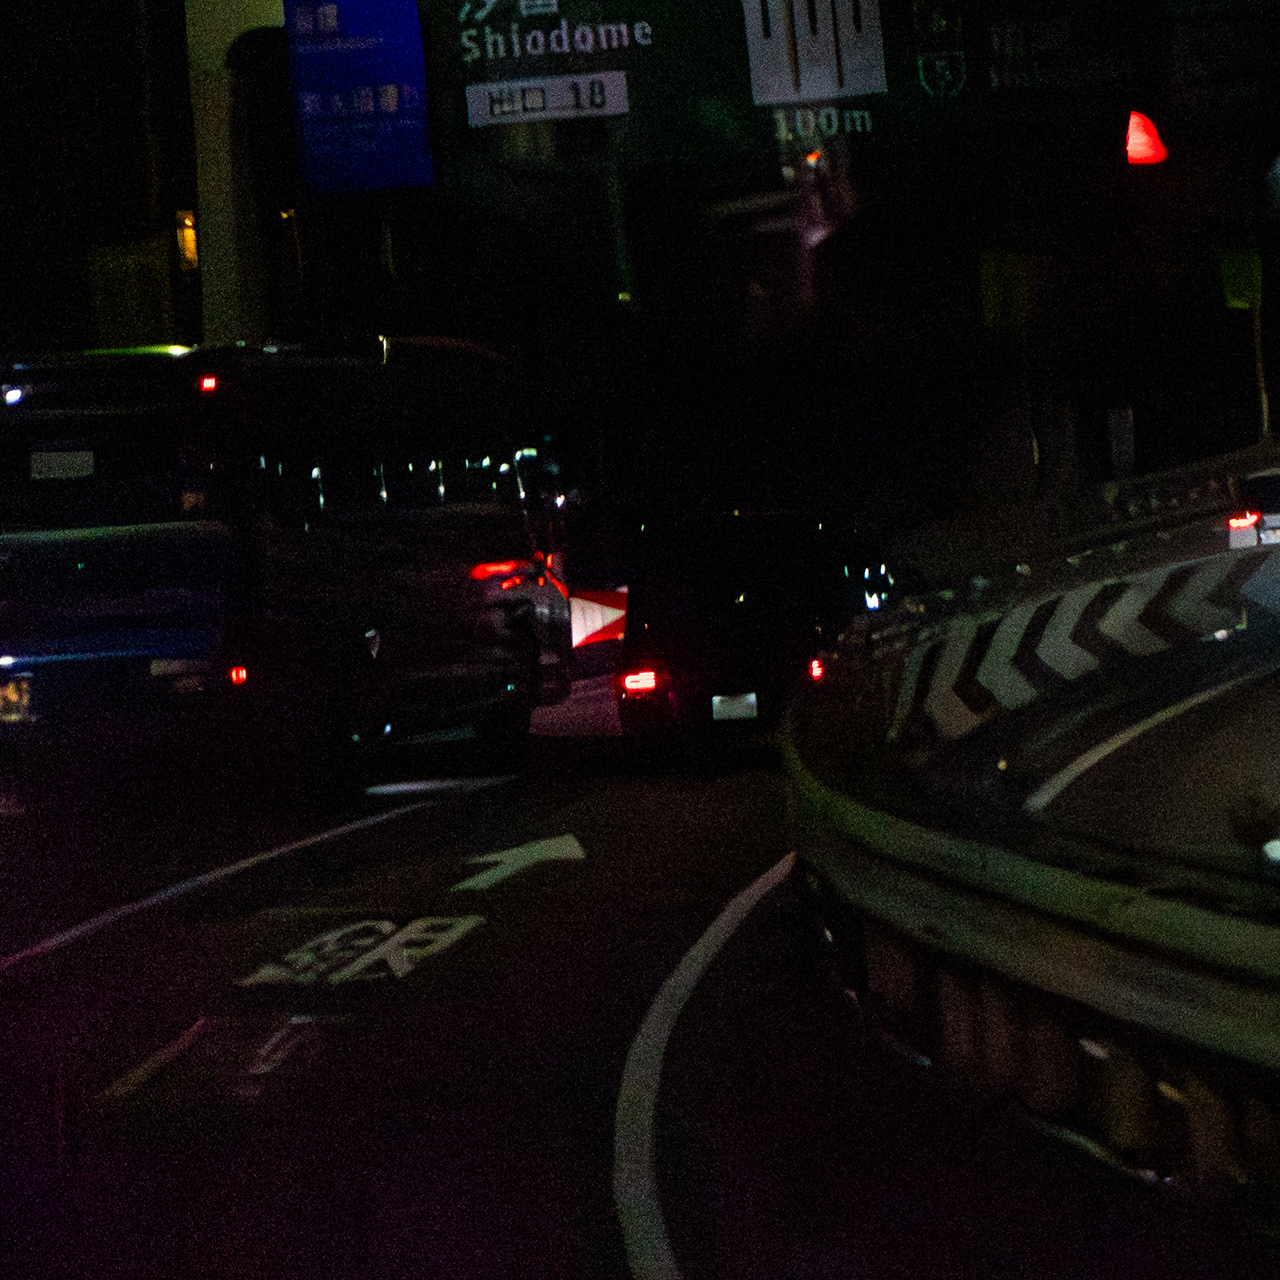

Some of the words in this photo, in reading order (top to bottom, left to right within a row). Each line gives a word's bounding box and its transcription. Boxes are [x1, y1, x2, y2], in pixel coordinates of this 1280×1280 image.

[459, 17, 653, 62] Shiodome
[488, 87, 546, 116] 出口
[569, 78, 607, 109] 18
[773, 108, 873, 142] 100m
